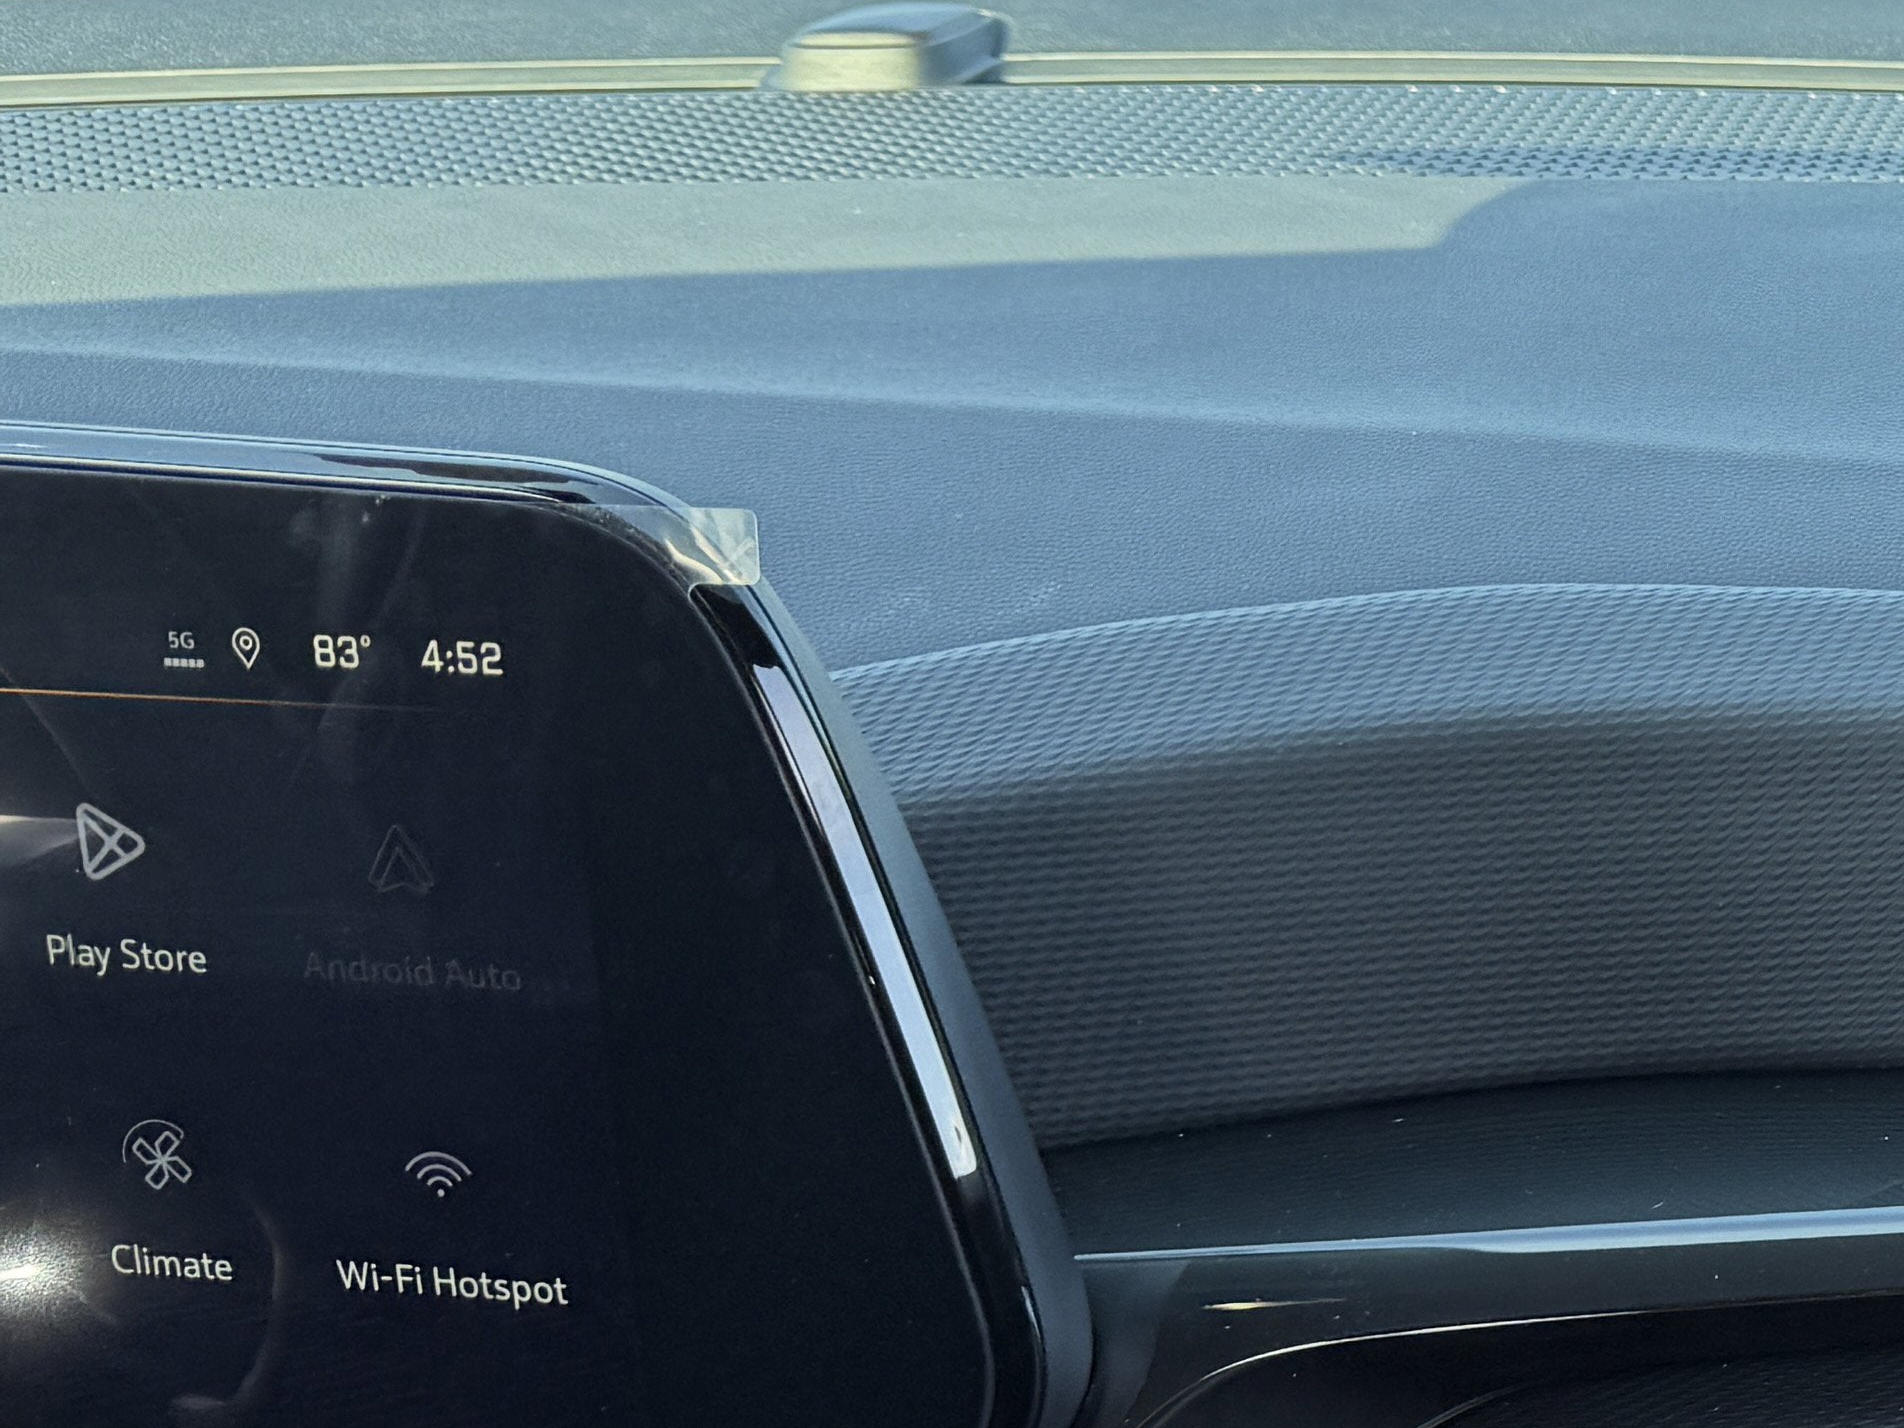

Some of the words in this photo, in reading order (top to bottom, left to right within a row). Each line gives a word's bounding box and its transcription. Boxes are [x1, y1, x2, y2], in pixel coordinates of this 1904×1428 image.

[167, 630, 196, 650] 5G
[421, 639, 504, 676] 4:52
[46, 934, 111, 976] Play
[119, 939, 208, 974] Store
[303, 952, 434, 988] Android
[444, 959, 522, 992] Auto
[110, 1243, 234, 1283] Climate
[336, 1259, 424, 1297] Wi-Fi
[432, 1265, 569, 1310] Hotspot
